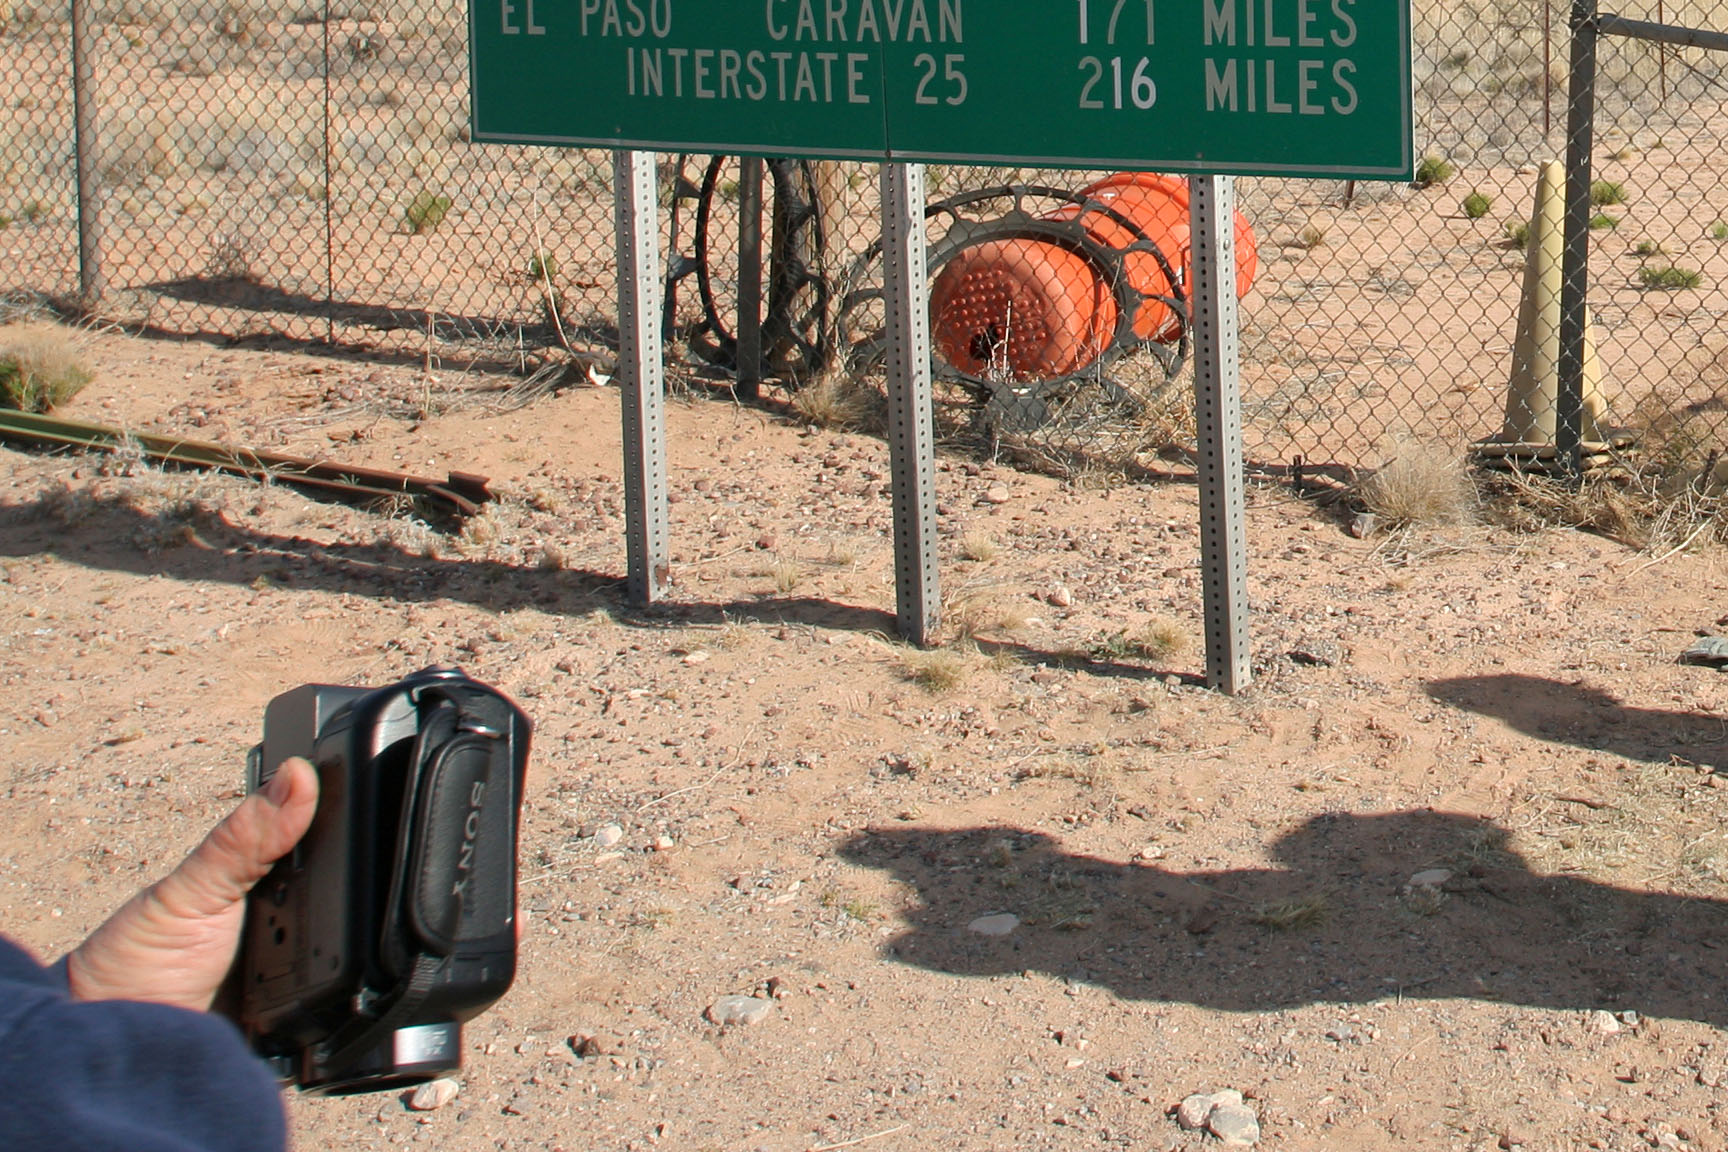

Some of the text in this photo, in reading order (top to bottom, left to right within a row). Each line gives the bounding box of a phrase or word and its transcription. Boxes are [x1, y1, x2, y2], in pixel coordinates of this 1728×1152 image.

[628, 48, 1357, 114] INTERSTATE 25 216 MILES
[452, 781, 486, 895] SONY
